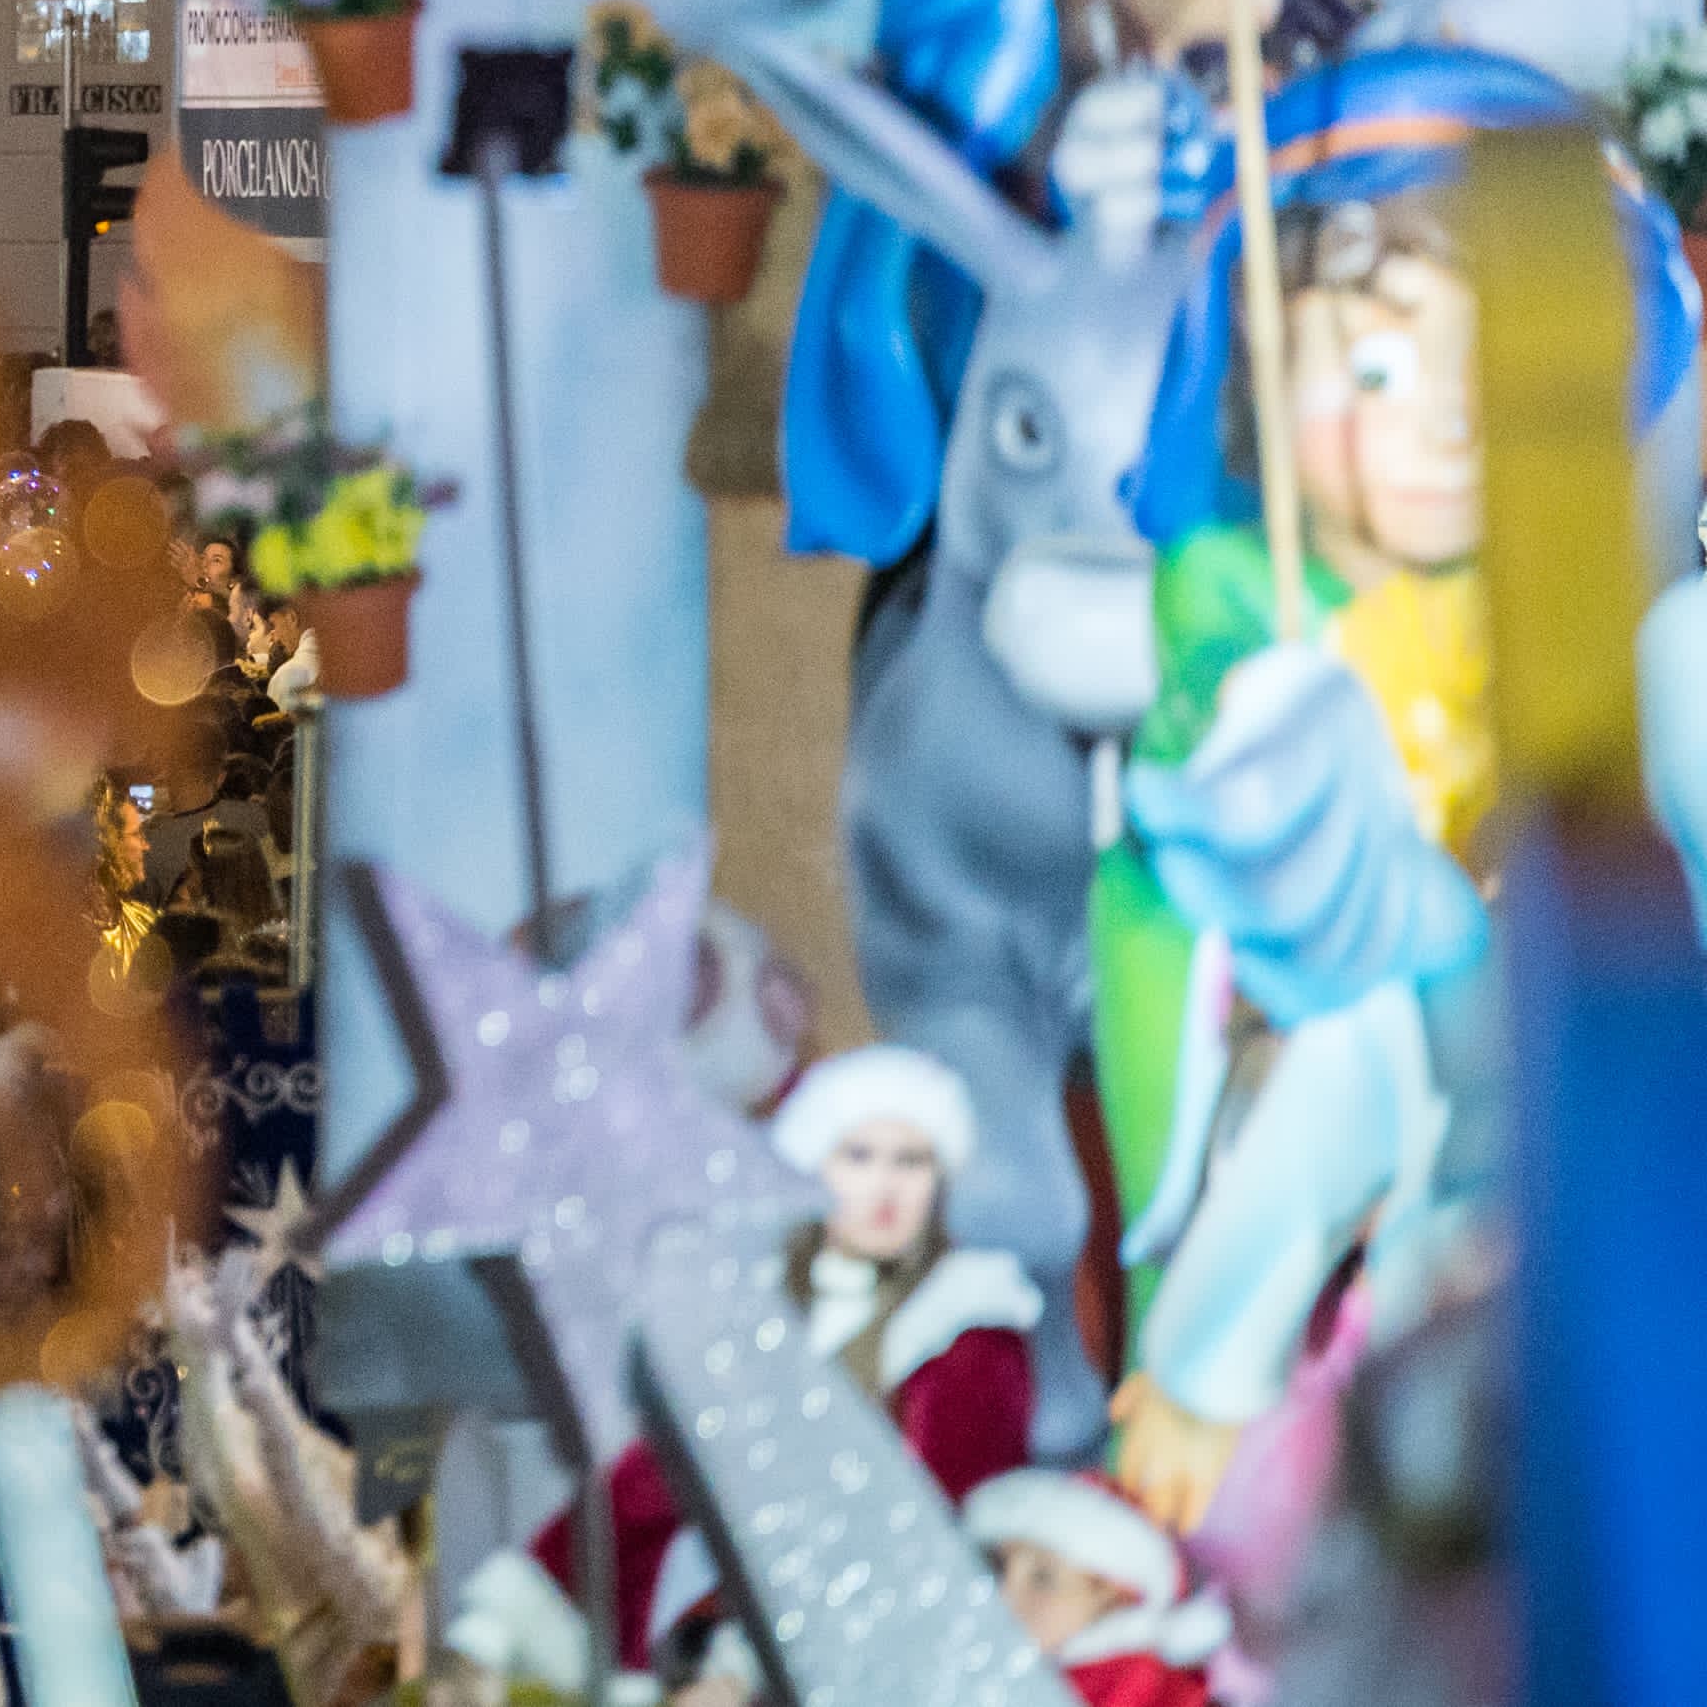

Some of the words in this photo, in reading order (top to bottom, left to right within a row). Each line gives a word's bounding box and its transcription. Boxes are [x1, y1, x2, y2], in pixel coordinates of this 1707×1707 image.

[187, 10, 258, 46] PROMOCIONES
[9, 85, 162, 116] FRACISCO
[202, 138, 321, 199] PORCELANOSA
